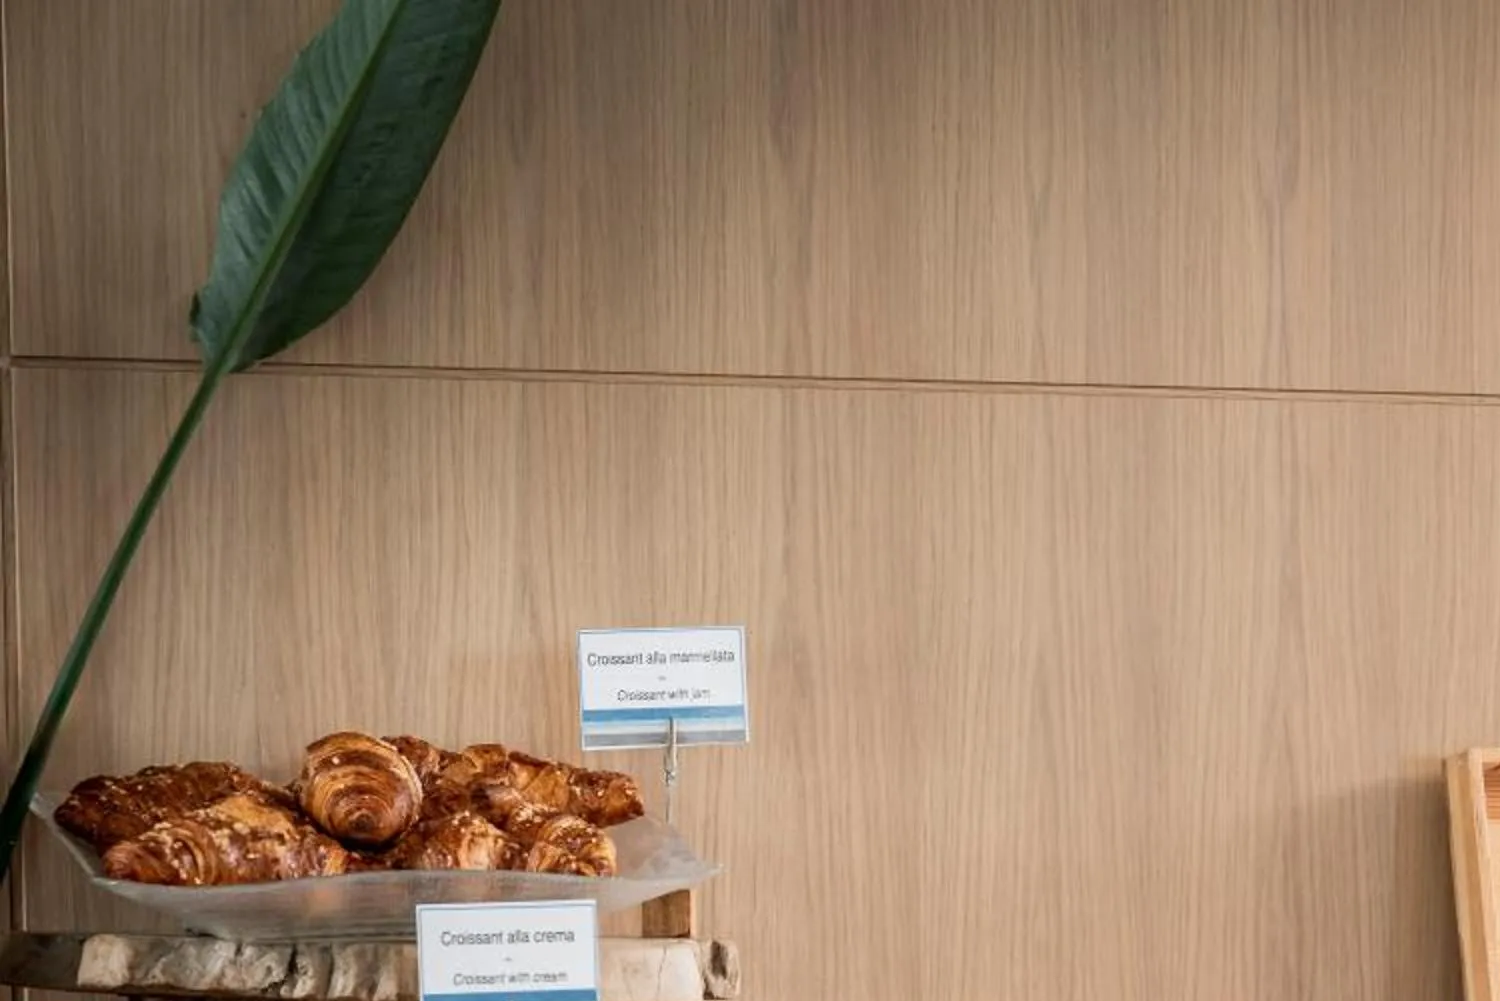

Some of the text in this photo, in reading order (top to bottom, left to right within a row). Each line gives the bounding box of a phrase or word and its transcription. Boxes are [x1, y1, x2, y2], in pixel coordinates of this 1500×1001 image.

[587, 652, 643, 667] Croissant
[645, 650, 667, 665] alla
[617, 689, 665, 701] Croissant
[668, 688, 688, 700] with
[441, 929, 575, 946] Croissant alla crema
[453, 972, 568, 986] Croissant with cream
